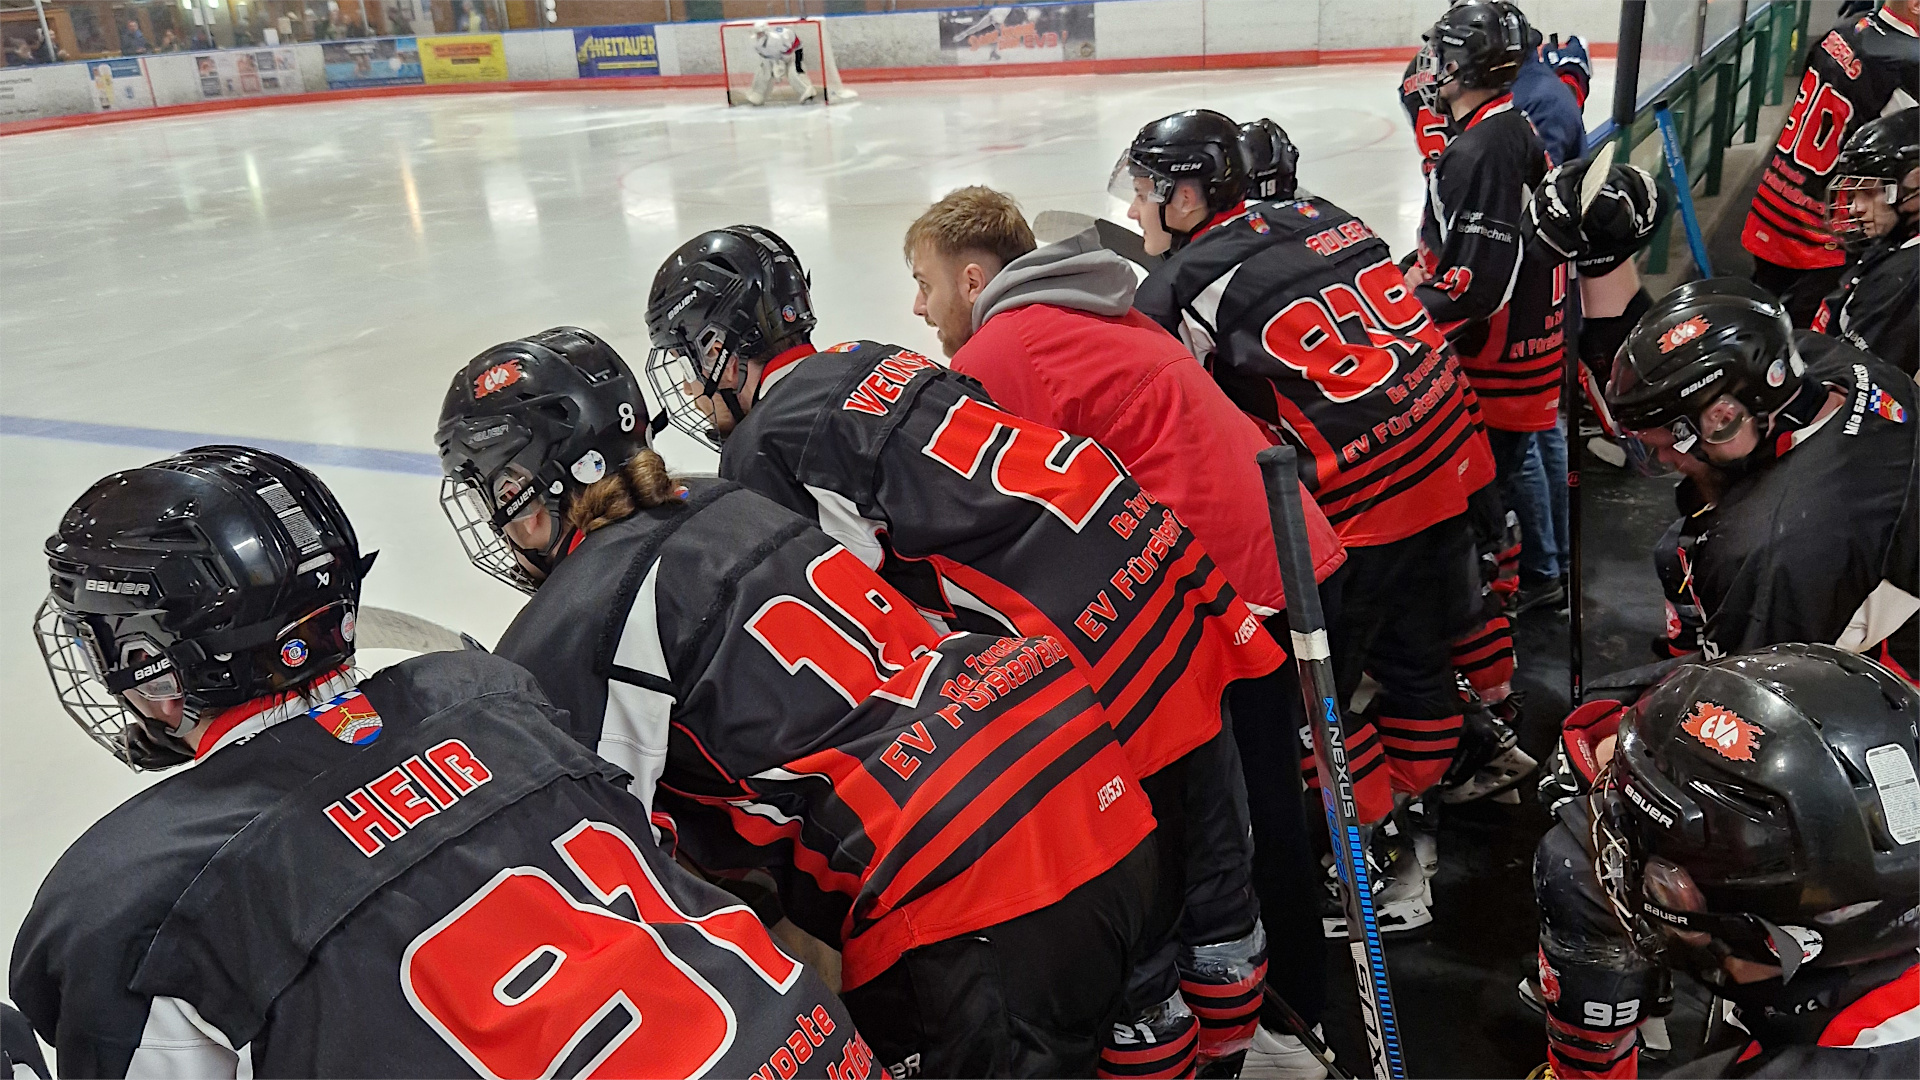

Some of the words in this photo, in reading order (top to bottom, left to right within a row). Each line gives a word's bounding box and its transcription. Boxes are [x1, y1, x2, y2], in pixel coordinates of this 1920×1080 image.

[1776, 67, 1854, 176] 30
[1170, 161, 1203, 172] CCM
[1260, 179, 1276, 198] 19
[1305, 220, 1378, 256] ADLER
[667, 289, 699, 321] BAUER
[712, 349, 728, 382] BAUER
[1679, 368, 1725, 398] BAUER
[618, 402, 636, 432] 8
[1853, 391, 1868, 414] san
[1342, 434, 1370, 463] EV
[921, 395, 1131, 534] 2
[507, 486, 535, 517] BAUER
[1108, 511, 1140, 540] De
[85, 579, 150, 596] BAUER
[743, 544, 943, 709] 18
[1074, 589, 1118, 642] EV
[134, 658, 171, 681] BAUE
[880, 721, 937, 781] EV
[1329, 726, 1356, 819] NEXUS
[1624, 783, 1674, 829] BAUER
[1643, 903, 1688, 926] BAUER
[400, 818, 804, 1080] 91
[1583, 999, 1640, 1026] 93
[1113, 1022, 1158, 1044] 21
